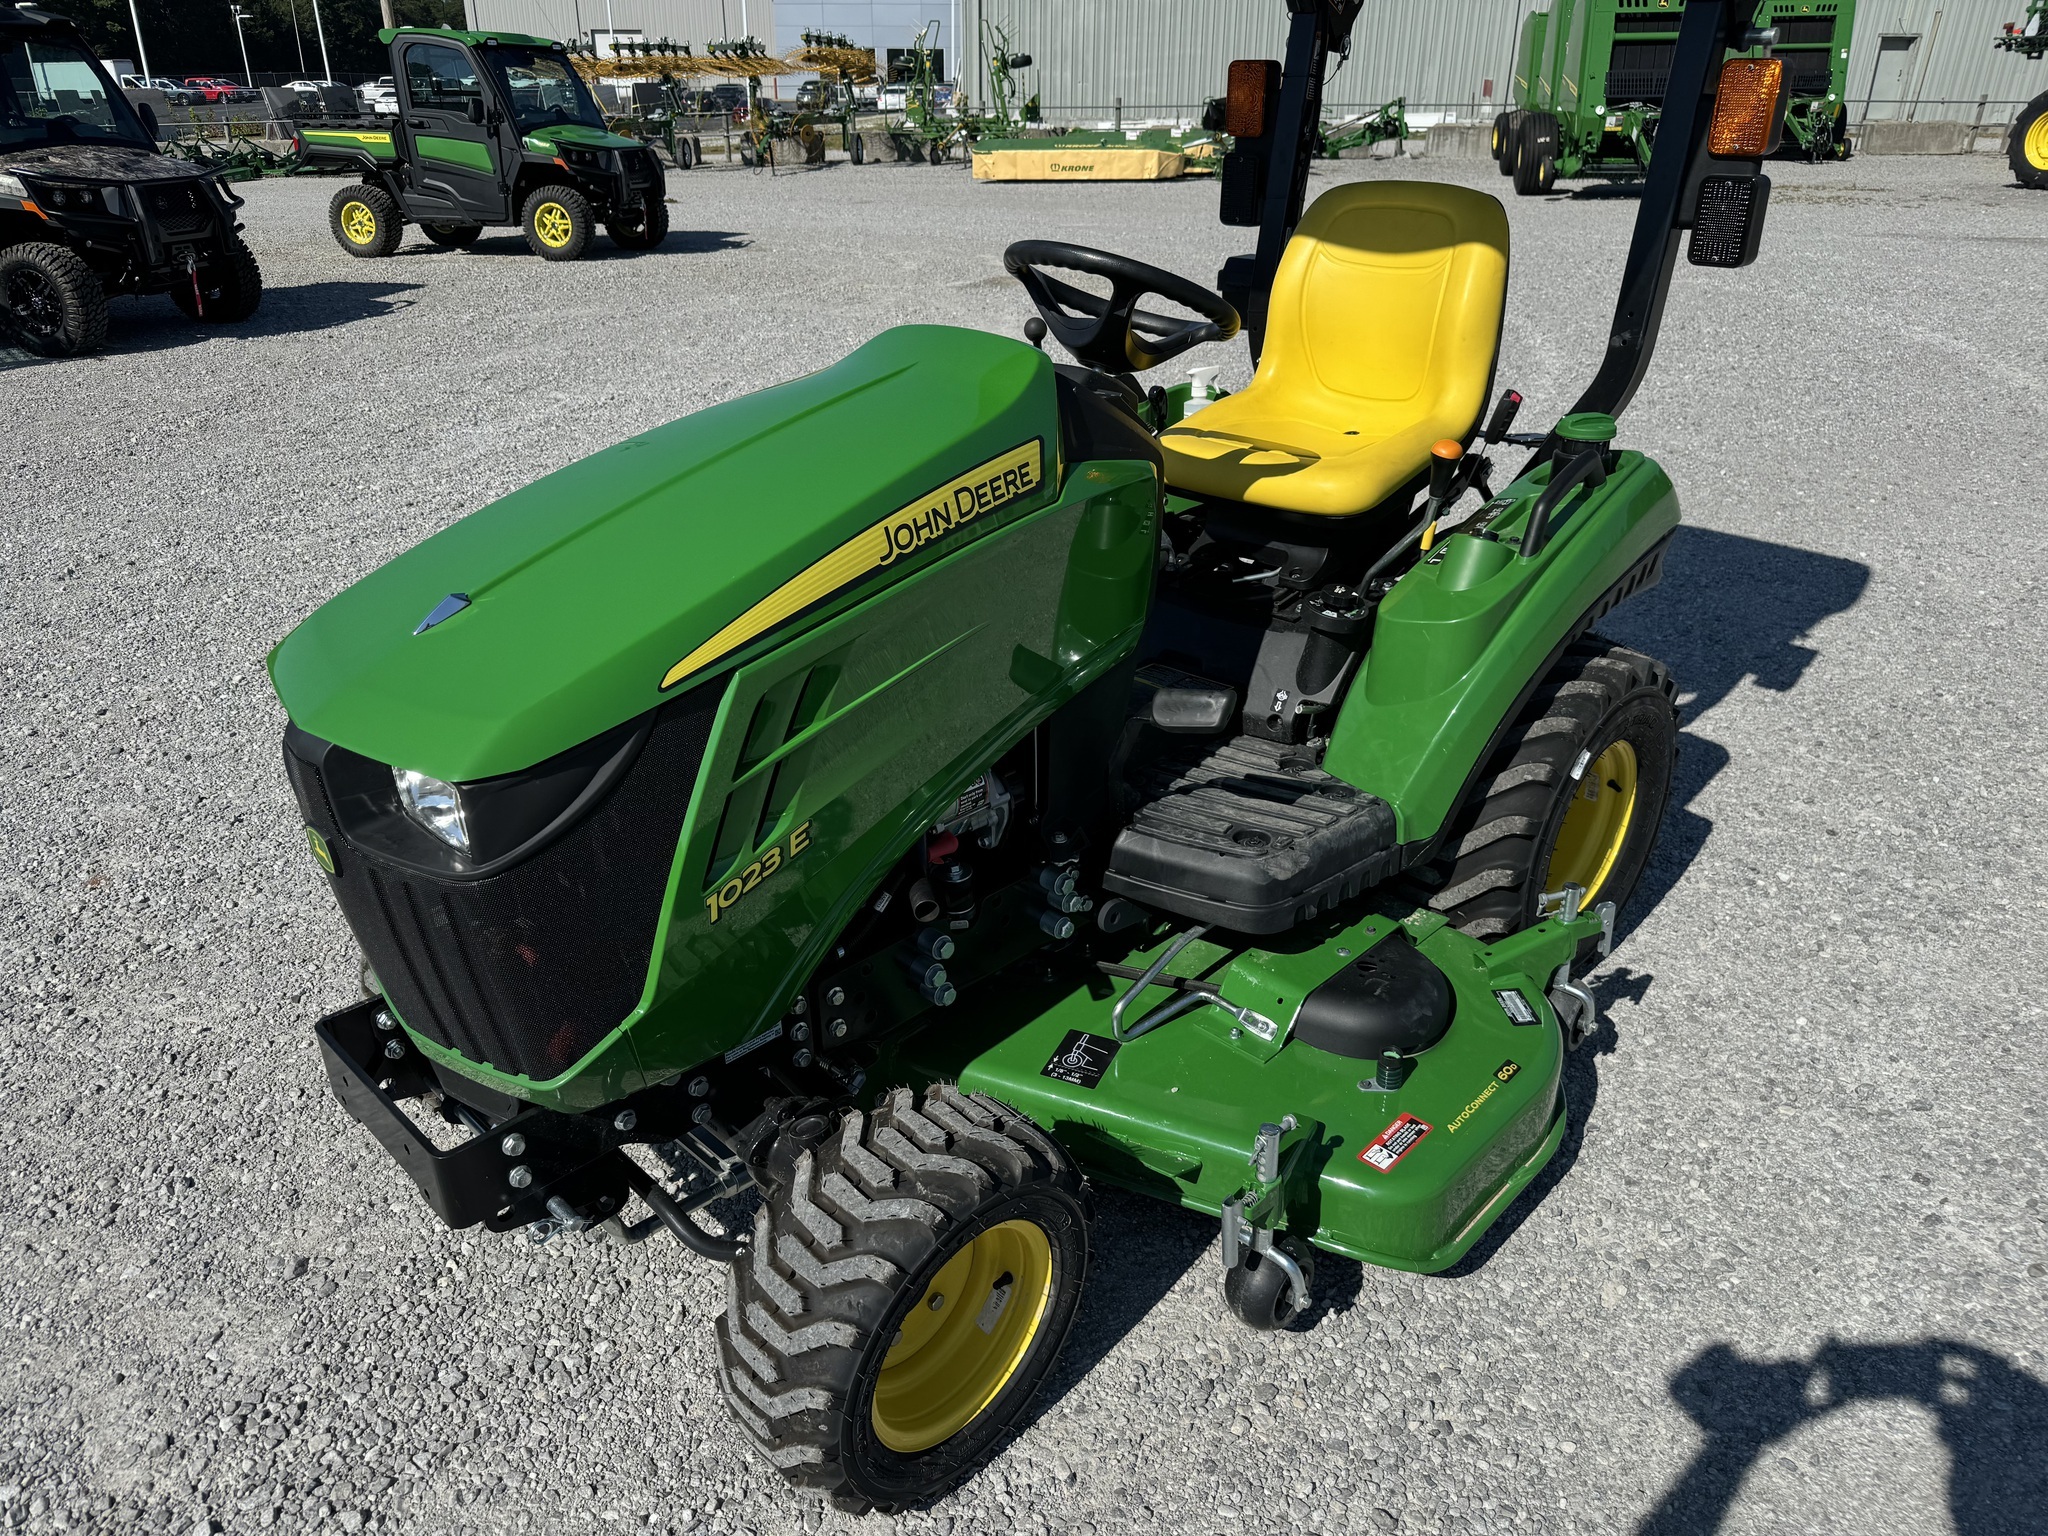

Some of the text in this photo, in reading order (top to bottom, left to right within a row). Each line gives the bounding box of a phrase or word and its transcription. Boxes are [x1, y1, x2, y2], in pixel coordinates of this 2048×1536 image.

[879, 461, 1035, 564] JOHN DEERE
[706, 820, 810, 924] 1023 E
[1385, 1120, 1403, 1135] DANGER
